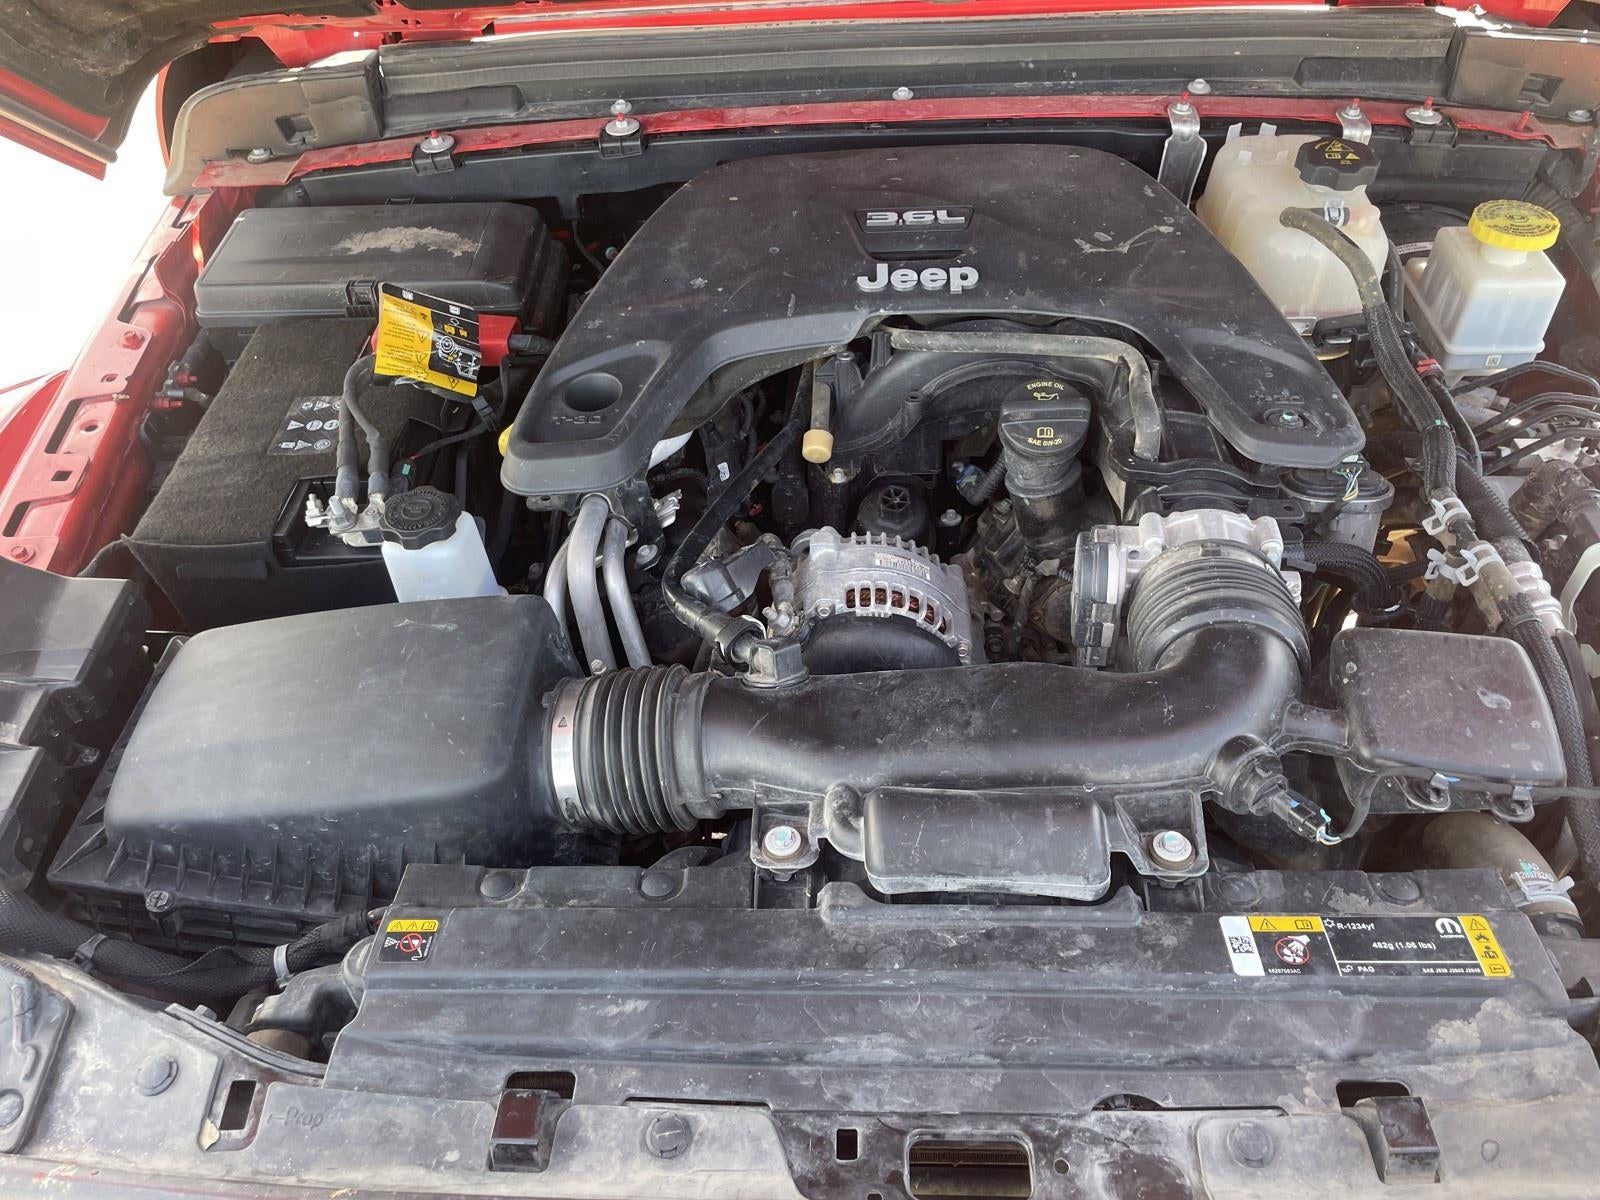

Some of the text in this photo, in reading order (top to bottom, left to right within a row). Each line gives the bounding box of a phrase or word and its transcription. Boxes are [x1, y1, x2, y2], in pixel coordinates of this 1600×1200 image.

[866, 209, 966, 227] 3.6L
[856, 262, 980, 295] Jeep
[1027, 381, 1065, 391] ENGINE OIL
[1027, 437, 1042, 446] SAE
[1336, 922, 1375, 931] R-1234yf
